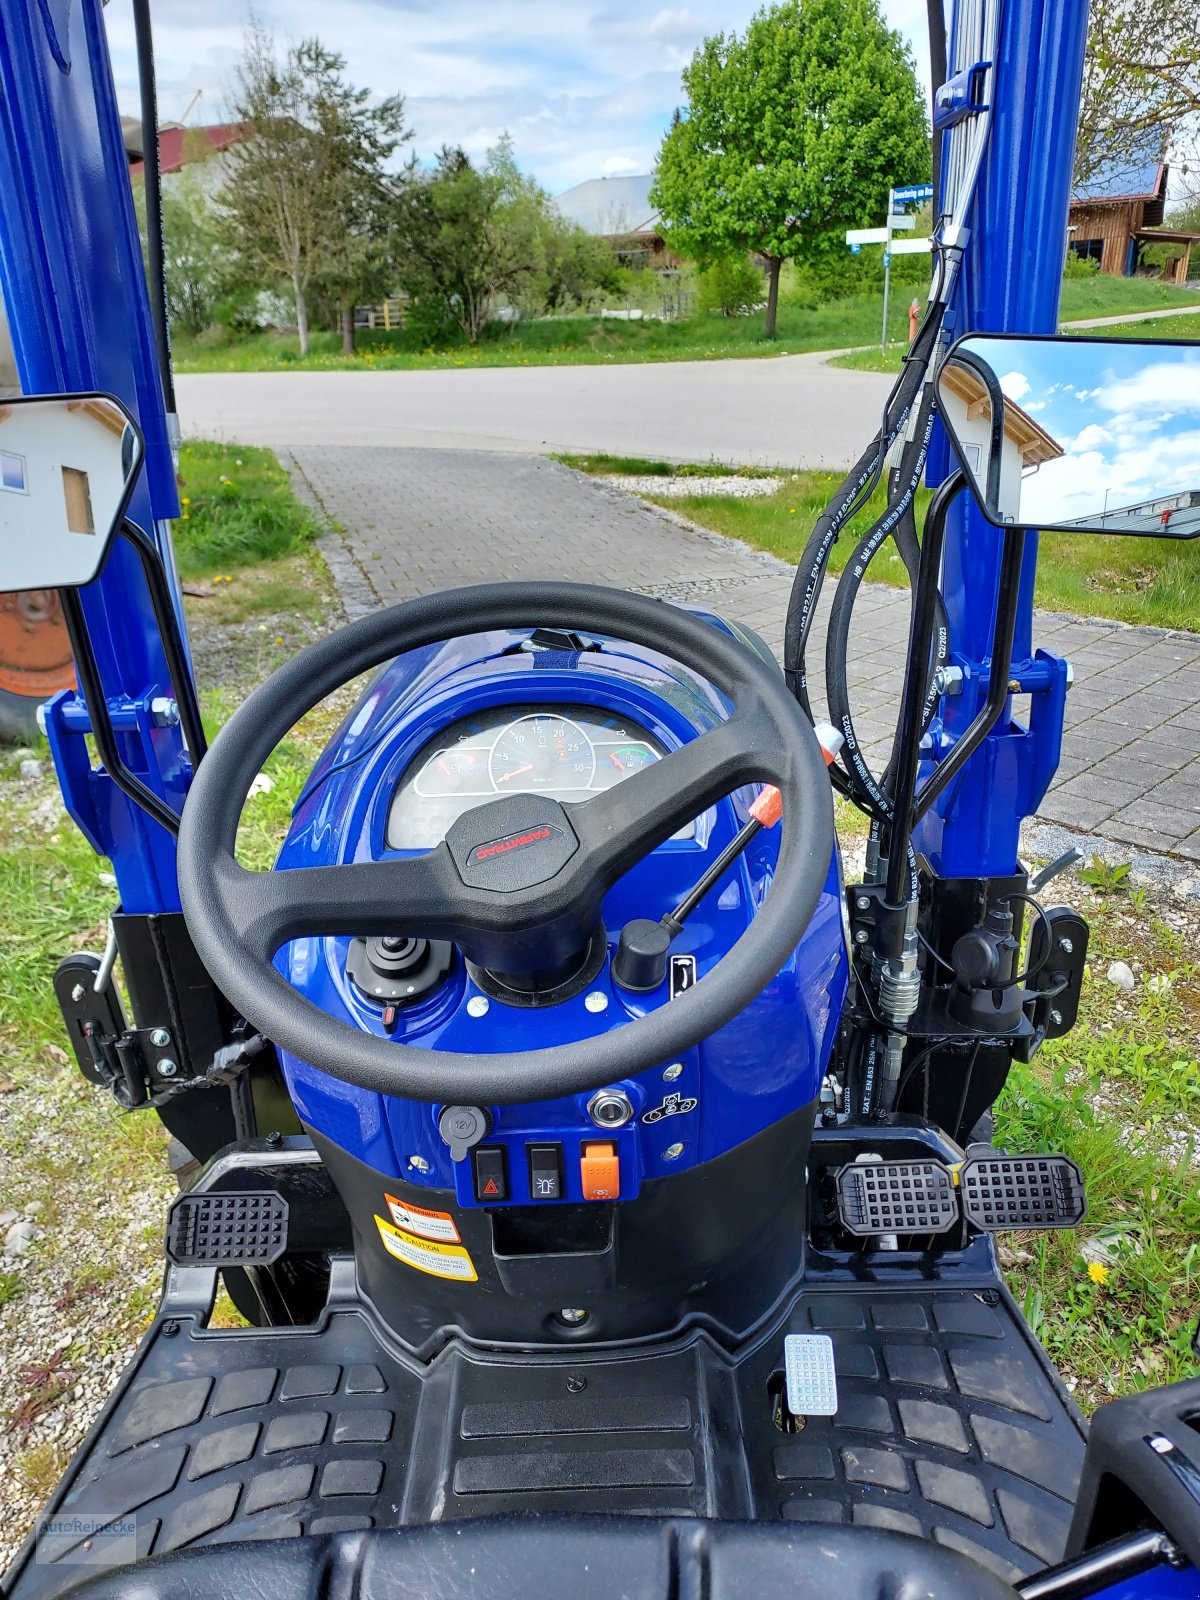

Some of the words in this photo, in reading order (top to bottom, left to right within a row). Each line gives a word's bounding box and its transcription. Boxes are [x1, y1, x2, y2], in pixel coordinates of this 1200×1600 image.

[853, 565, 863, 578] HB
[860, 547, 872, 562] SAE
[923, 414, 935, 445] 350BAR
[938, 627, 947, 658] Q2/2023
[532, 726, 542, 734] 15
[553, 729, 564, 738] 20
[842, 714, 856, 750] Q2/2023
[568, 743, 579, 751] 25
[572, 764, 584, 772] 30
[853, 752, 868, 783] 350BAR
[476, 828, 550, 859] FARMTRAC
[866, 1080, 873, 1091] EN
[455, 1120, 471, 1130] 12V
[405, 1236, 440, 1252] CAUTION
